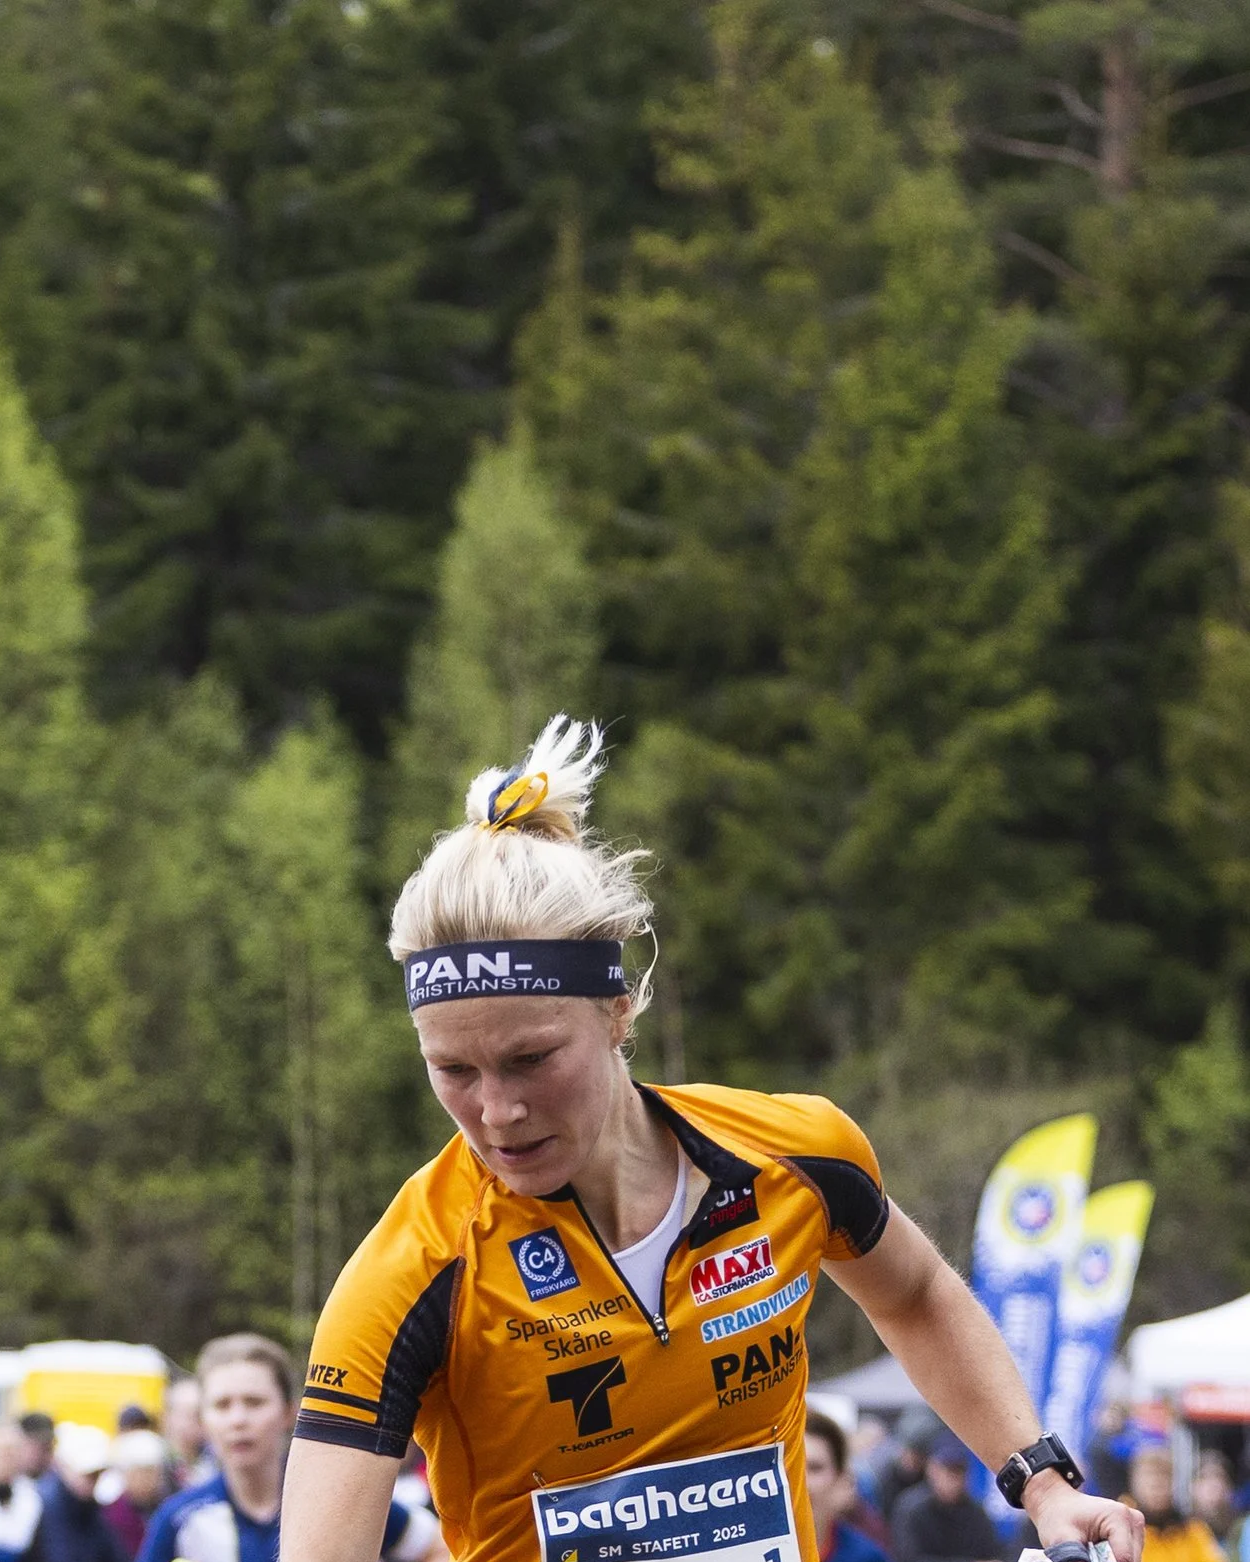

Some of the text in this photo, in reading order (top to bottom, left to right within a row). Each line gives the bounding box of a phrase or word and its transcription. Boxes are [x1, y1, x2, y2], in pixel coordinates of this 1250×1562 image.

[410, 952, 533, 990] PAN-
[410, 977, 561, 1003] KRISTIANSTAD
[528, 1247, 556, 1269] C4
[691, 1243, 771, 1295] MAXI
[696, 1266, 775, 1304] ICA STORMARKNAD
[506, 1294, 632, 1342] Sparbanken
[702, 1273, 809, 1342] STRANDVILLAN
[544, 1330, 613, 1361] Skåne
[710, 1324, 800, 1393] PAN-
[544, 1469, 780, 1536] bagheera
[598, 1523, 747, 1559] SM STAFETT 2025
